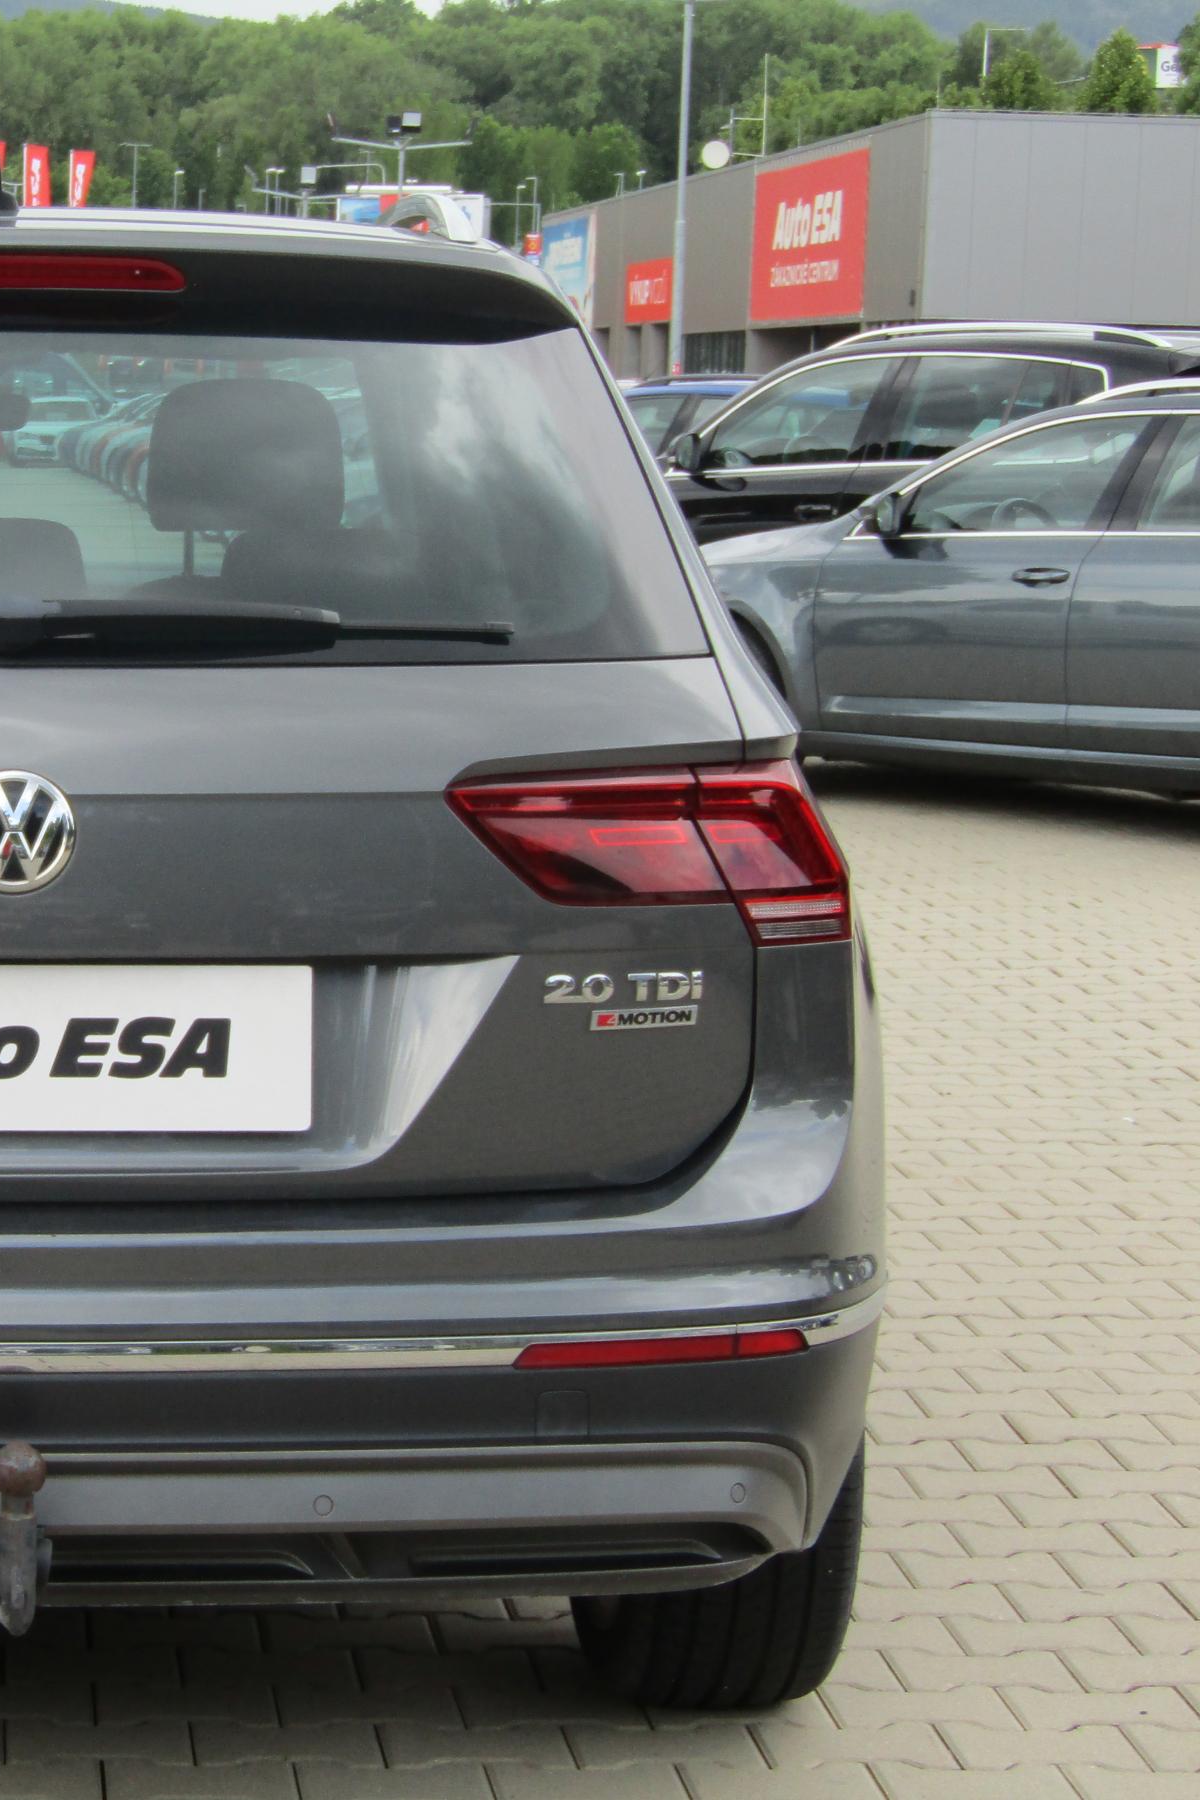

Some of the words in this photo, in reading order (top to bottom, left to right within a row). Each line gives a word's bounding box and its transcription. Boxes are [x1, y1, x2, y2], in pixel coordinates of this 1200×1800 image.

[772, 198, 811, 251] Auto
[810, 190, 843, 245] ESA
[48, 1016, 232, 1079] ESA
